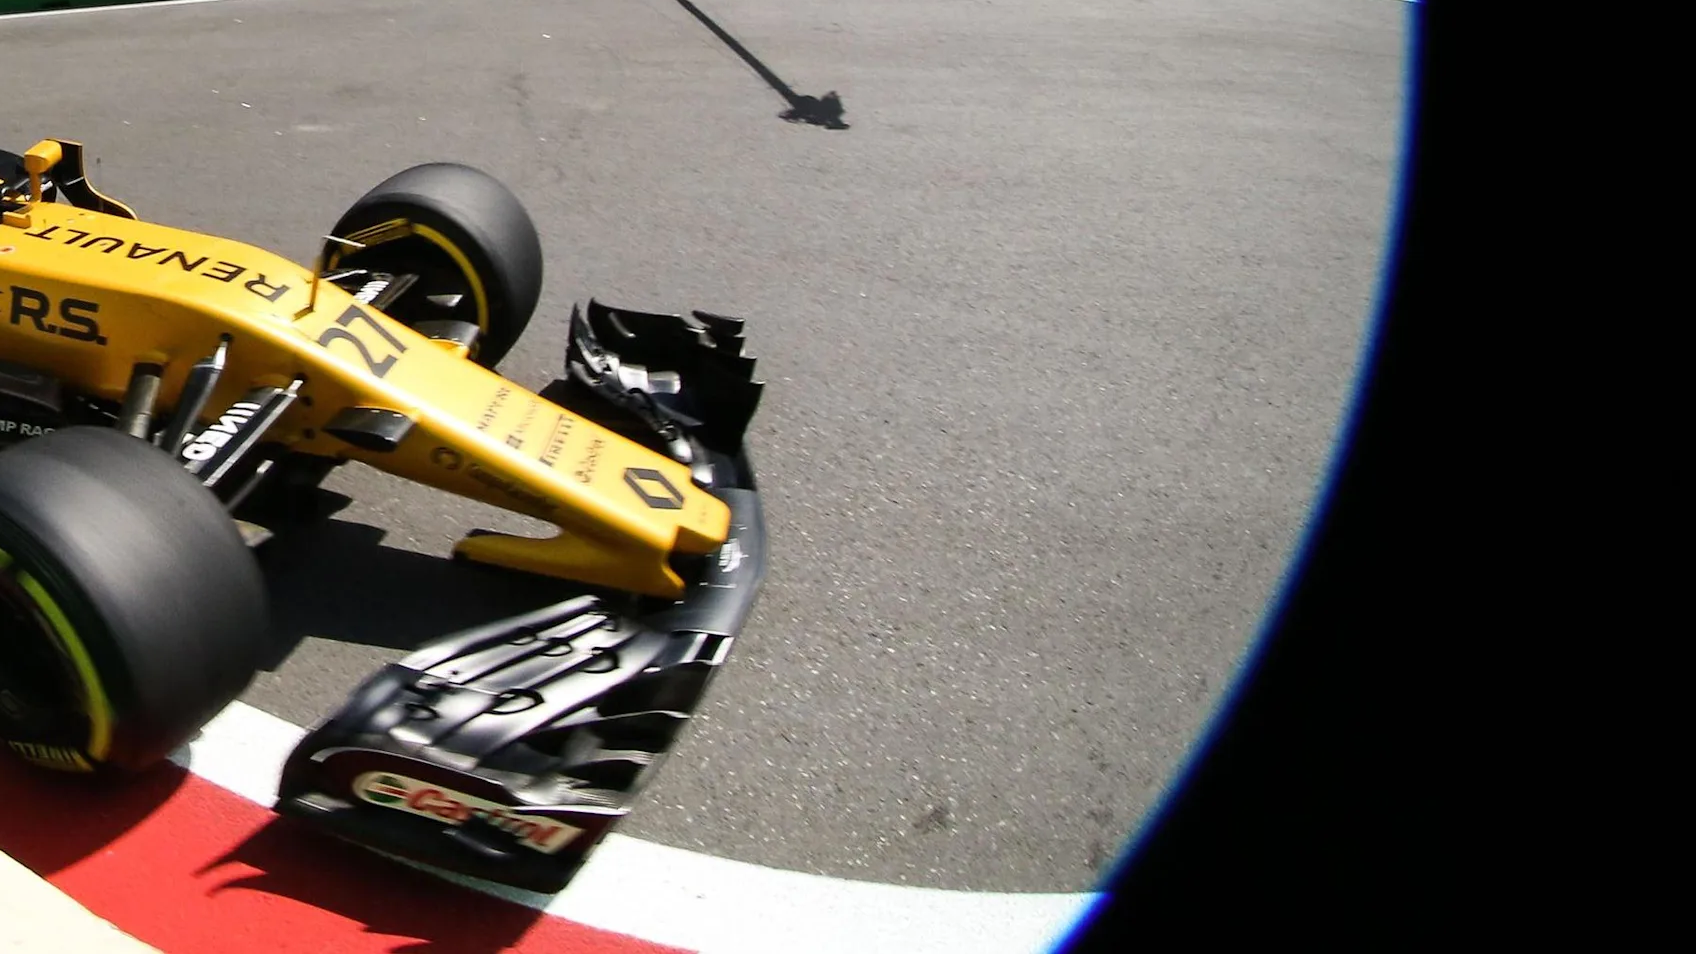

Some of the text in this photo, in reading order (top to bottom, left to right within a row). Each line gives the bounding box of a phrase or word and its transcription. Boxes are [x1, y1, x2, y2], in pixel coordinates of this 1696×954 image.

[23, 224, 292, 303] RENAULT
[9, 285, 107, 346] R.S.
[317, 304, 408, 379] 27
